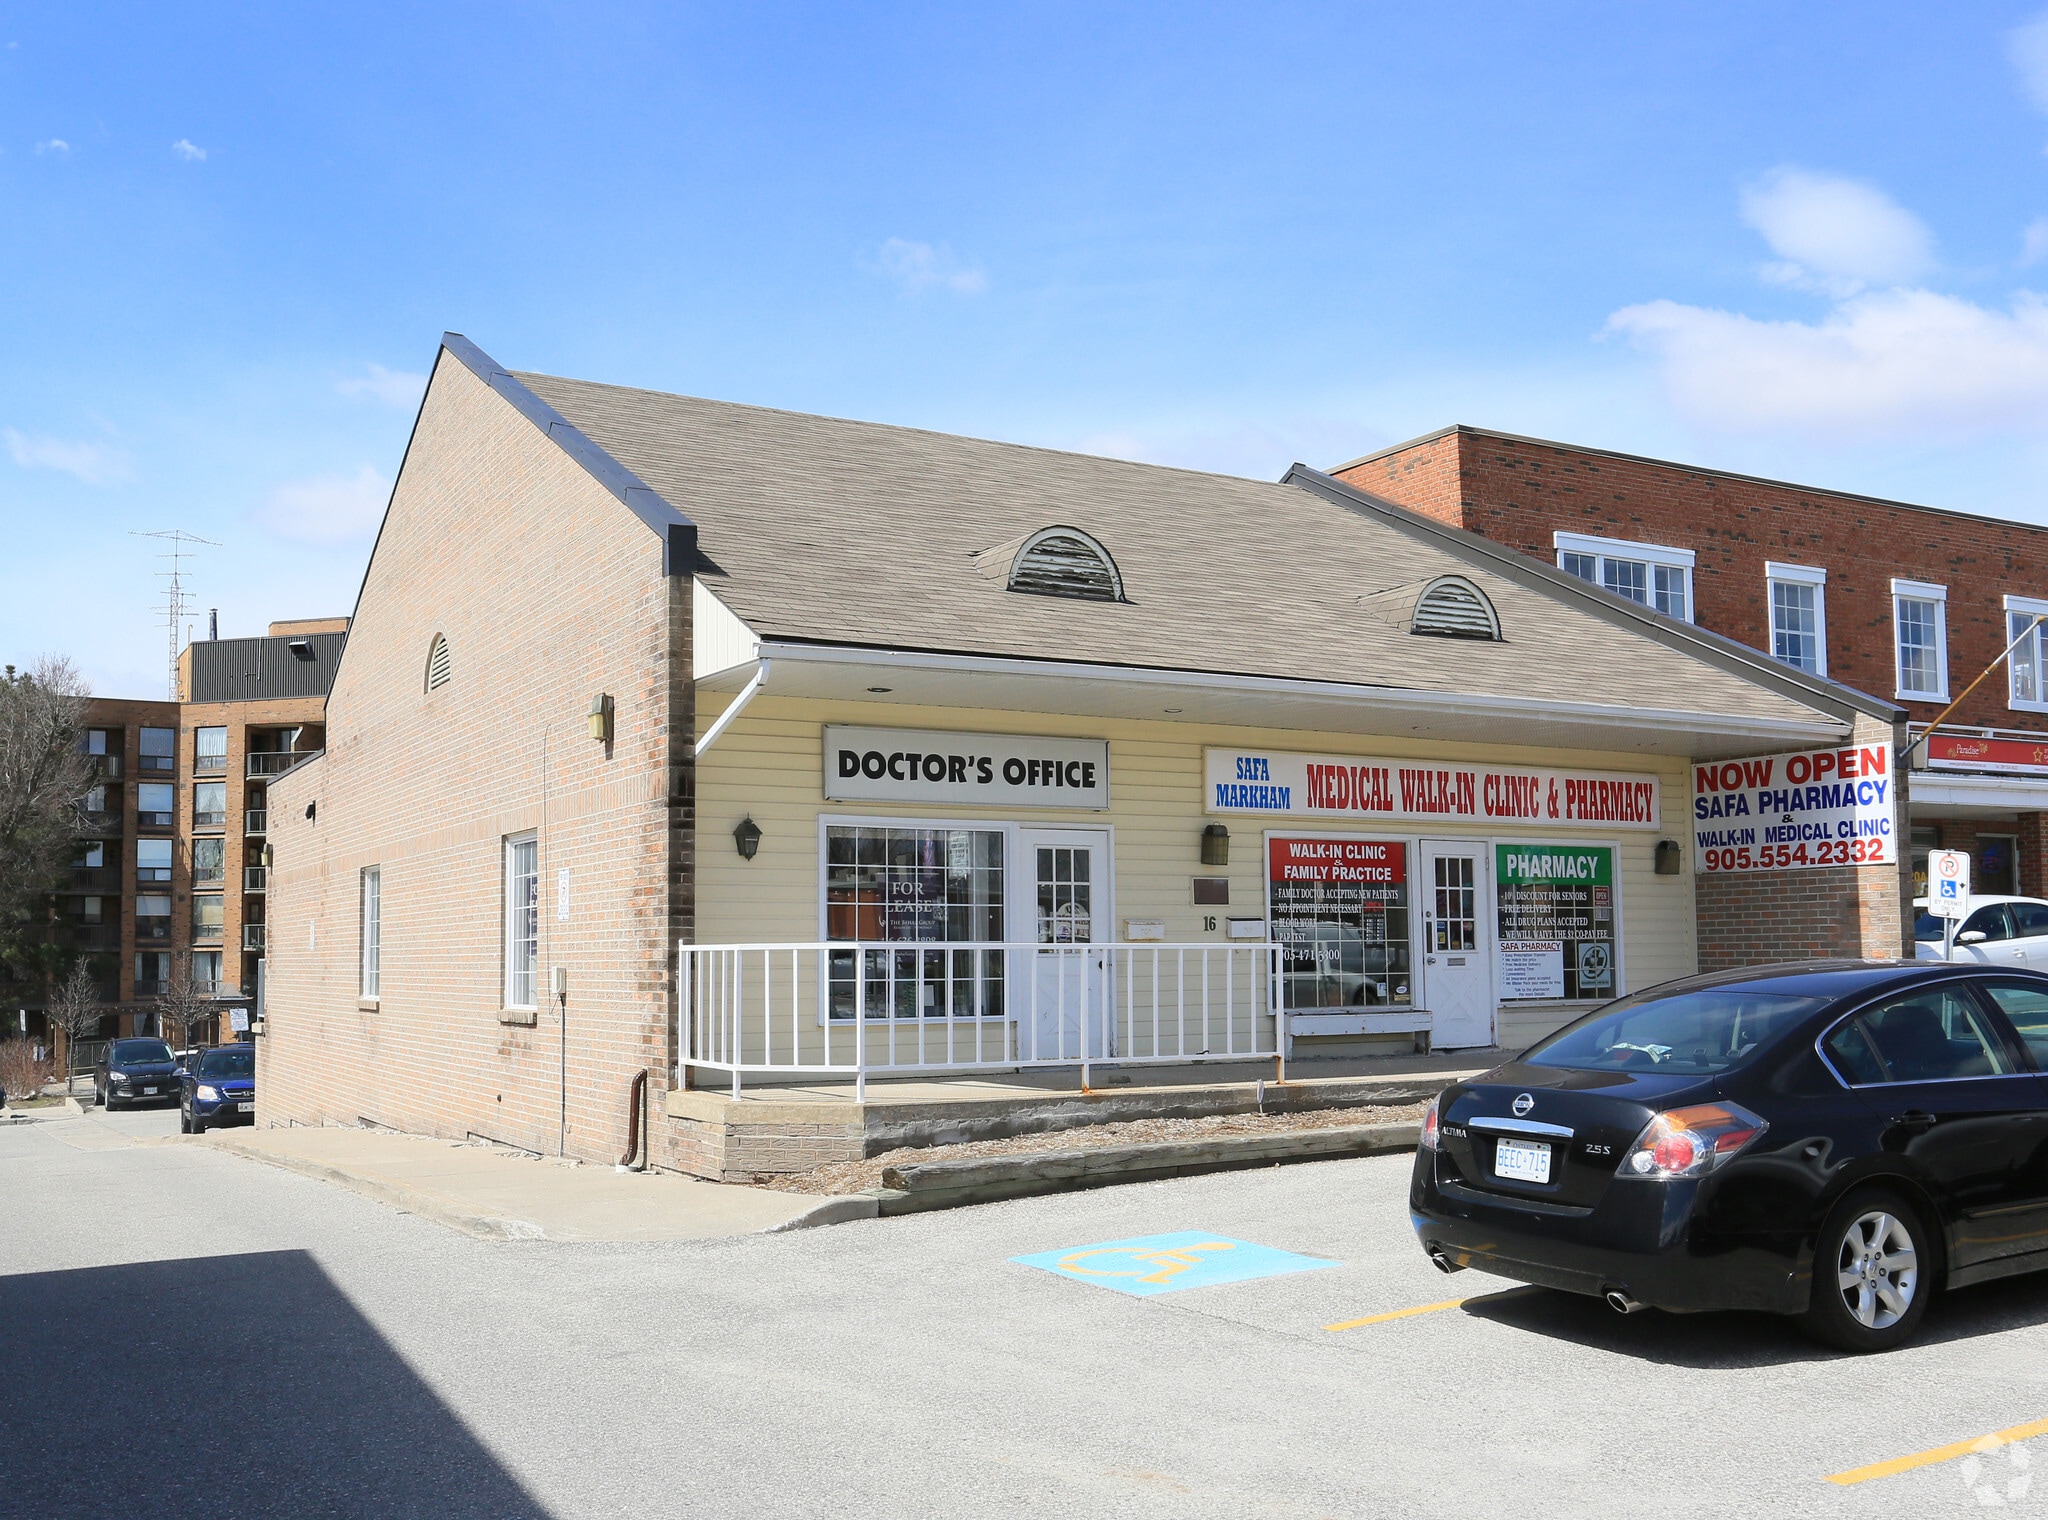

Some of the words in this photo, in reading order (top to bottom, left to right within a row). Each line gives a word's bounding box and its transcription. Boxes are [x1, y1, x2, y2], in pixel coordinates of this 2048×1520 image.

[1956, 744, 1979, 755] Paradise
[838, 750, 994, 784] DOCTOR'S
[1002, 758, 1096, 788] OFFICE
[1236, 757, 1270, 781] SAFA
[1696, 758, 1774, 794] NOW
[1786, 746, 1886, 785] OPEN
[1216, 784, 1291, 810] MARKHAM
[1307, 764, 1393, 811] MEDICAL
[1399, 769, 1475, 815] WALK-IN
[1483, 774, 1539, 818] CLINIC
[1547, 777, 1559, 819] &
[1565, 779, 1653, 822] PHARMACY
[1695, 793, 1750, 820] SAFA
[1759, 780, 1888, 814] PHARMACY
[1781, 814, 1794, 823] &
[1697, 828, 1755, 848] WALK-IN
[1765, 822, 1832, 843] MEDICAL
[1837, 818, 1890, 838] CLINIC
[1289, 843, 1342, 858] WALK-IN
[1346, 845, 1386, 860] CLINIC
[1705, 838, 1884, 871] 905.554.2332
[1284, 865, 1328, 879] FAMILY
[1332, 866, 1392, 880] PRACTICE
[1506, 854, 1598, 879] PHARMACY
[891, 882, 924, 895] FOR
[1278, 888, 1300, 898] FAMILY
[1301, 888, 1325, 899] DOCTOR
[1326, 889, 1358, 899] ACCEPTING
[1358, 889, 1371, 899] NEW
[1372, 889, 1398, 900] PATIENTS
[1516, 892, 1547, 900] DISCOUNT
[1548, 892, 1561, 900] FOR
[1562, 892, 1587, 900] SENIORS
[884, 900, 932, 912] LEASE
[1278, 903, 1287, 913] NO
[1289, 903, 1329, 913] APPOINTMENT
[1329, 903, 1362, 913] NECESSARY
[1505, 904, 1521, 913] FREE
[1521, 904, 1551, 913] DELIVERY
[1203, 916, 1217, 931] 16
[1279, 918, 1298, 928] BLOOD
[1505, 917, 1517, 926] ALL
[1518, 917, 1536, 926] DRUG
[1537, 917, 1556, 926] PLANS
[1557, 917, 1588, 926] ACCEPTED
[1597, 930, 1608, 938] FEE
[1500, 942, 1519, 950] SAFA
[1521, 942, 1561, 950] PHARMACY
[1441, 1126, 1467, 1138] ALTIMA
[1498, 1147, 1522, 1168] BEEC
[1529, 1151, 1548, 1173] 715
